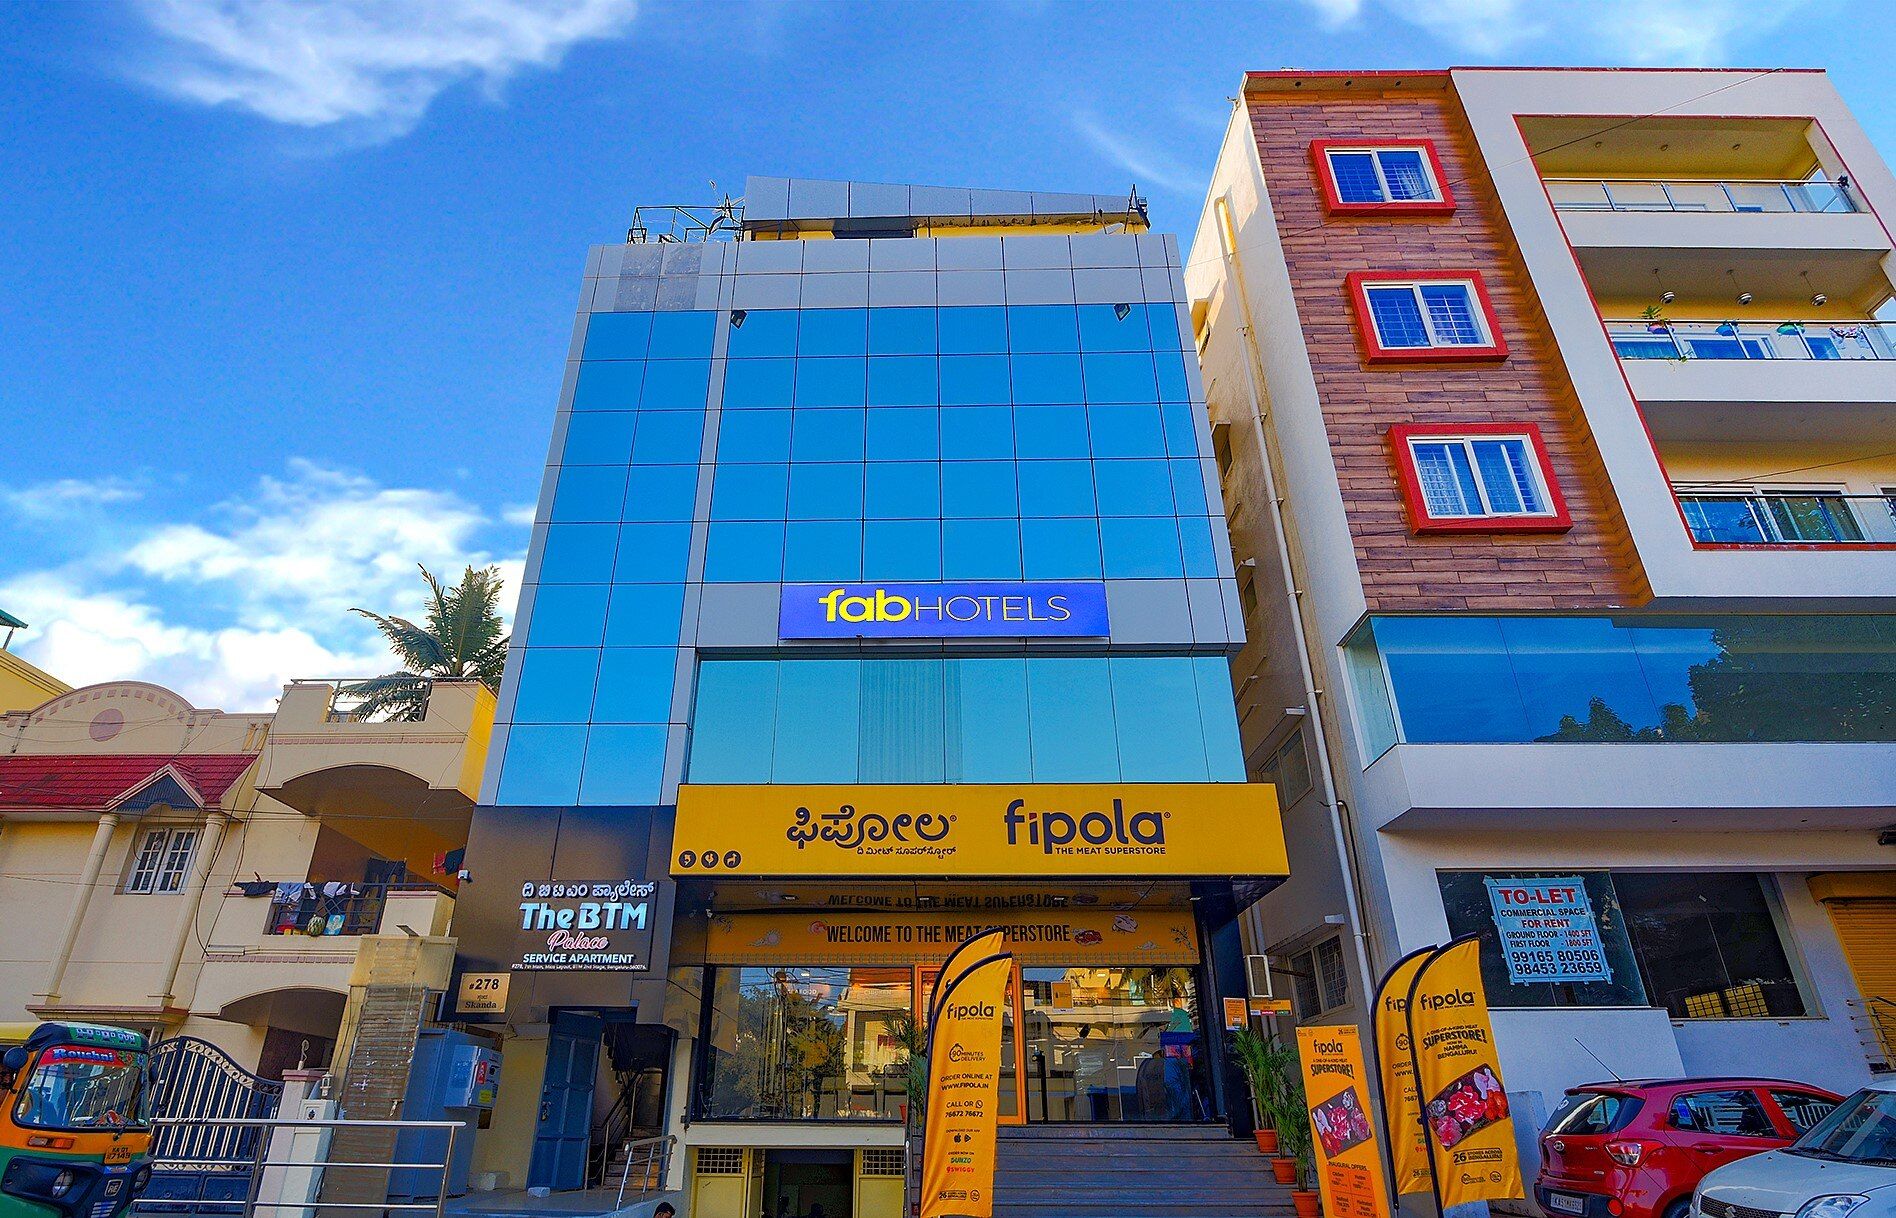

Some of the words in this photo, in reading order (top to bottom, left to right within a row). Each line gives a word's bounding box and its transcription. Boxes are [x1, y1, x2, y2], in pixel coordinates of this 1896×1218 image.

[1004, 799, 1165, 854] fipola
[1498, 888, 1575, 905] TO-LET
[519, 902, 574, 929] The
[577, 902, 647, 929] BTM
[1501, 908, 1558, 917] COMMERCIAL
[1559, 907, 1586, 916] SPACE
[1522, 920, 1542, 928] FOR
[1544, 919, 1570, 928] RENT
[827, 925, 892, 942] WELCOME
[895, 925, 912, 942] TO
[916, 925, 941, 942] THE
[985, 925, 1070, 942] PERSTORE
[1506, 931, 1537, 939] GROUND
[1538, 930, 1558, 938] FLOOR
[1581, 929, 1592, 937] SFT
[546, 929, 609, 952] Palace
[1510, 940, 1527, 948] FIRST
[523, 953, 567, 963] SERVICE
[569, 953, 634, 963] APARTMENT
[1512, 951, 1553, 962] 99165
[1558, 950, 1599, 961] 80506
[1515, 963, 1557, 974] 98453
[1560, 962, 1602, 974] 23659
[469, 978, 499, 990] #278
[465, 1001, 497, 1009] Skanda
[1385, 996, 1406, 1012] fip
[1420, 989, 1474, 1010] fipola
[947, 1001, 994, 1020] fipola
[1422, 1028, 1487, 1050] SUPERSTORE!
[1313, 1038, 1343, 1055] fipola
[941, 1073, 960, 1082] ORDER
[941, 1082, 989, 1091] WWW.FIPOLA.IN
[1453, 1152, 1467, 1163] 26
